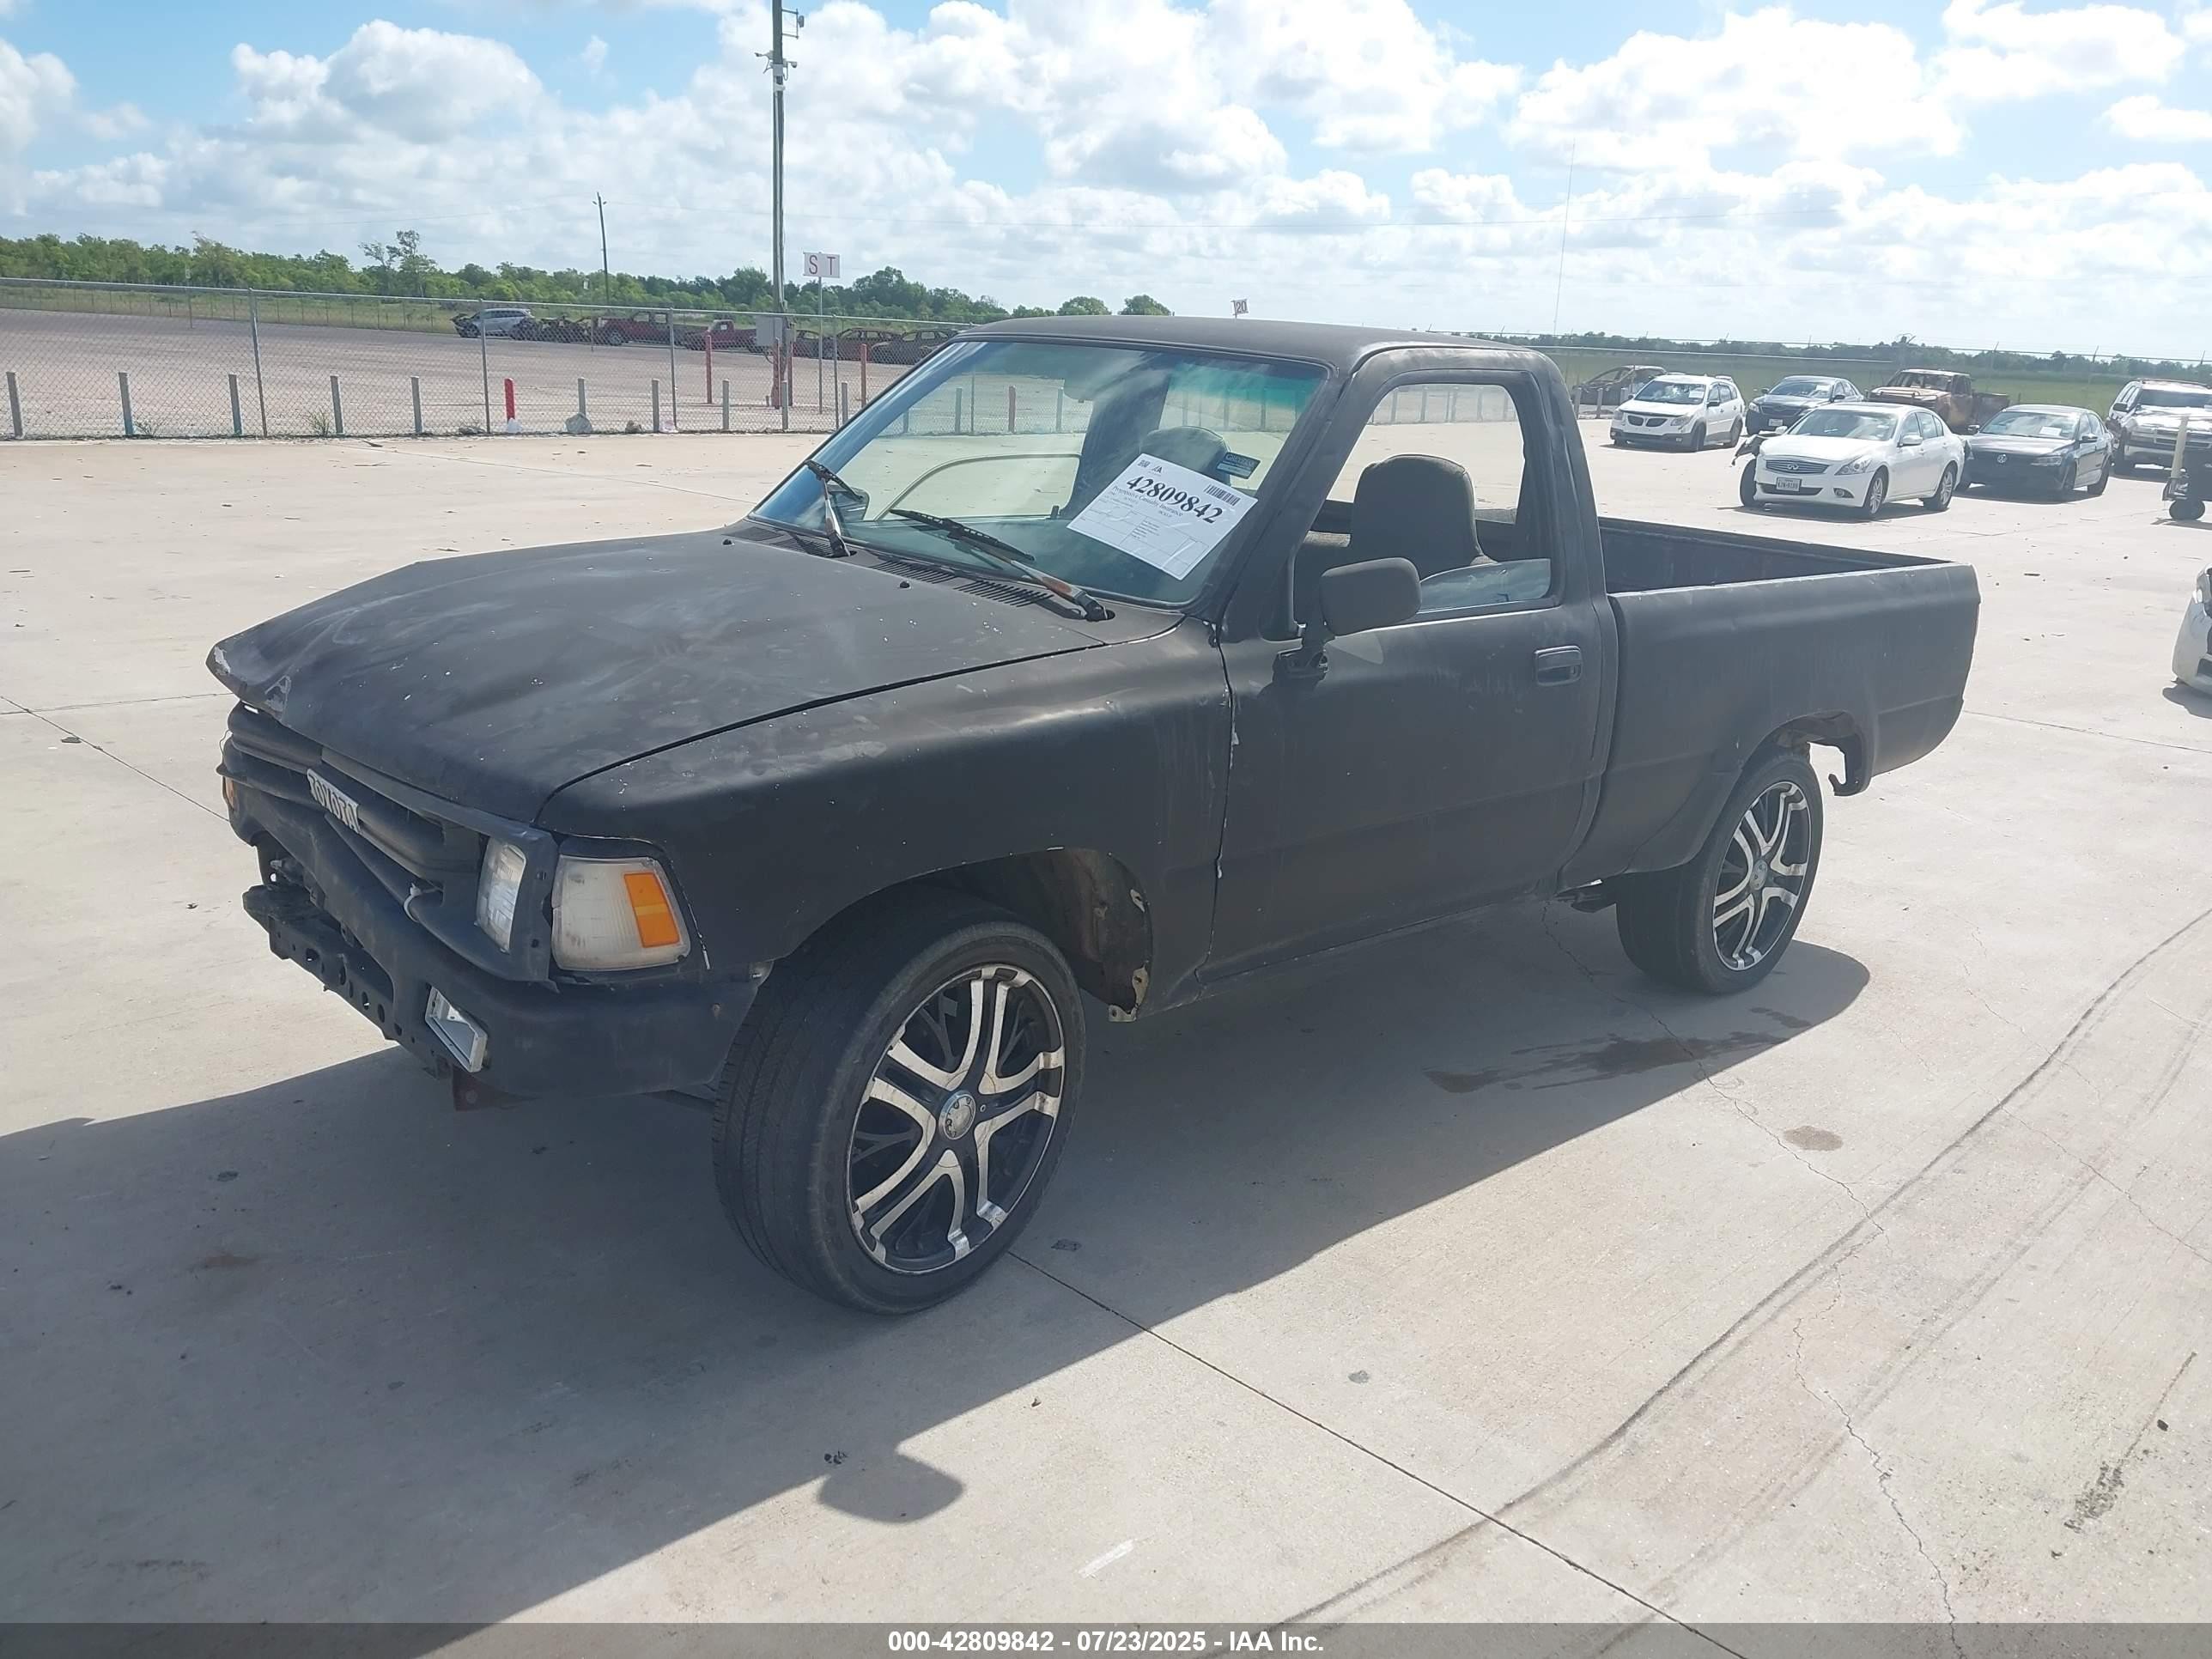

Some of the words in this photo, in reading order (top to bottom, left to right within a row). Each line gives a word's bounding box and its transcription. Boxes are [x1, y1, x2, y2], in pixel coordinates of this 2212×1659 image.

[809, 255, 817, 275] S
[827, 256, 836, 276] T
[1236, 301, 1247, 313] 20
[1126, 476, 1224, 524] 42809842
[308, 773, 362, 834] TOYOTA
